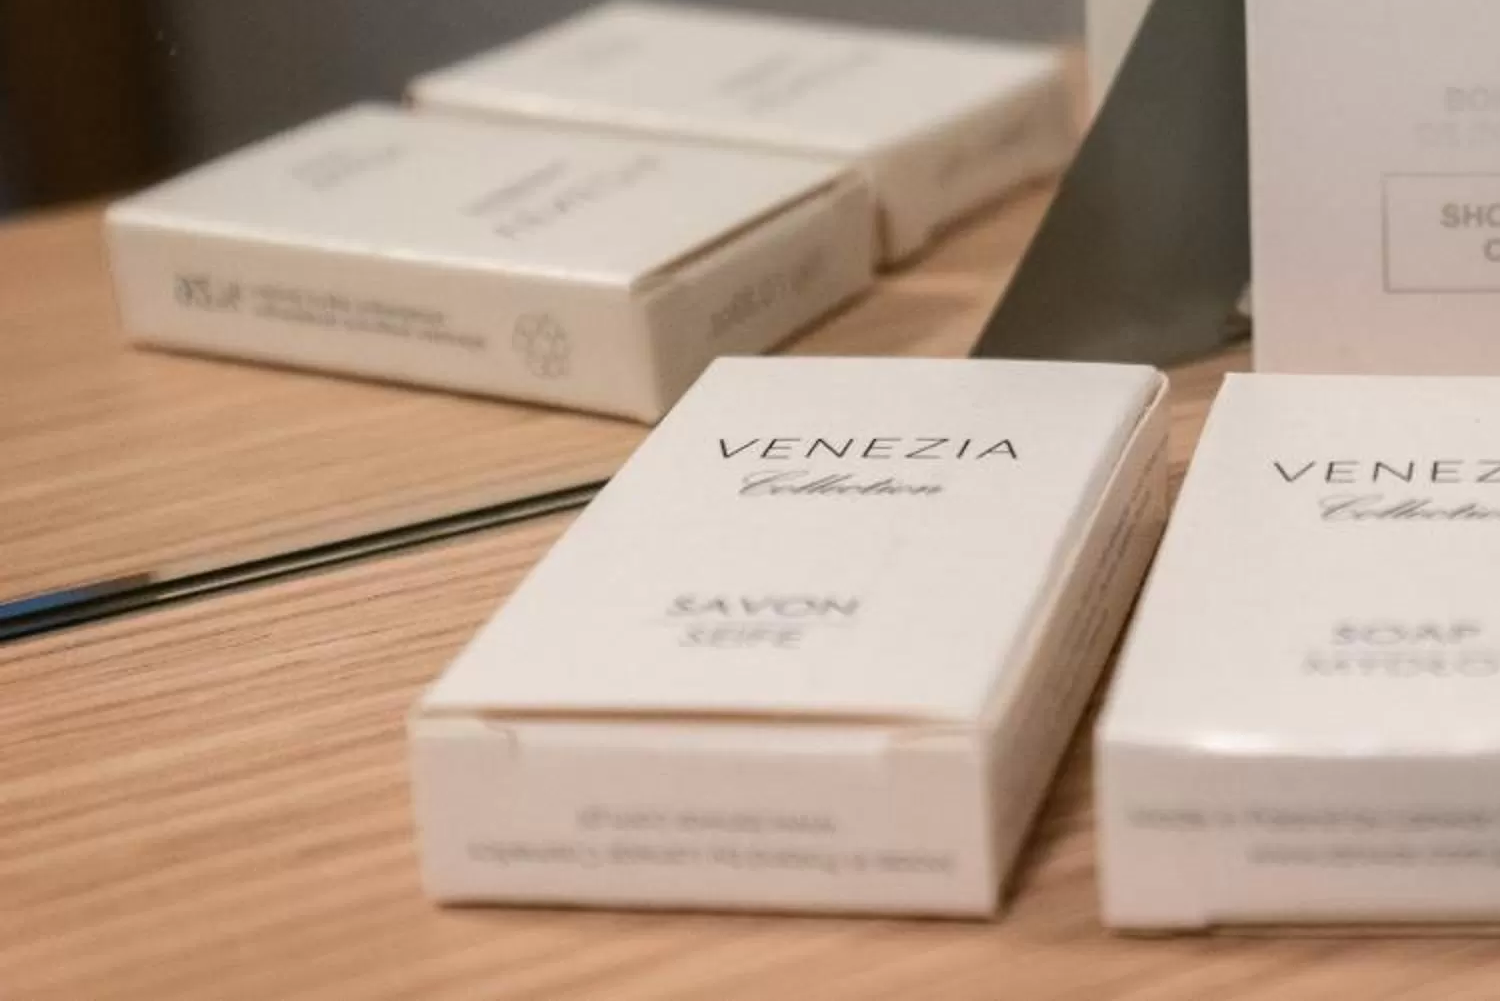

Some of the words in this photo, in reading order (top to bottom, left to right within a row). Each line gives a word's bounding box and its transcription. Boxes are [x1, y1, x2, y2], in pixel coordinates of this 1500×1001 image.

[717, 437, 1019, 461] VENEZIA
[665, 593, 861, 617] SAVON
[1330, 617, 1483, 646] SOAP
